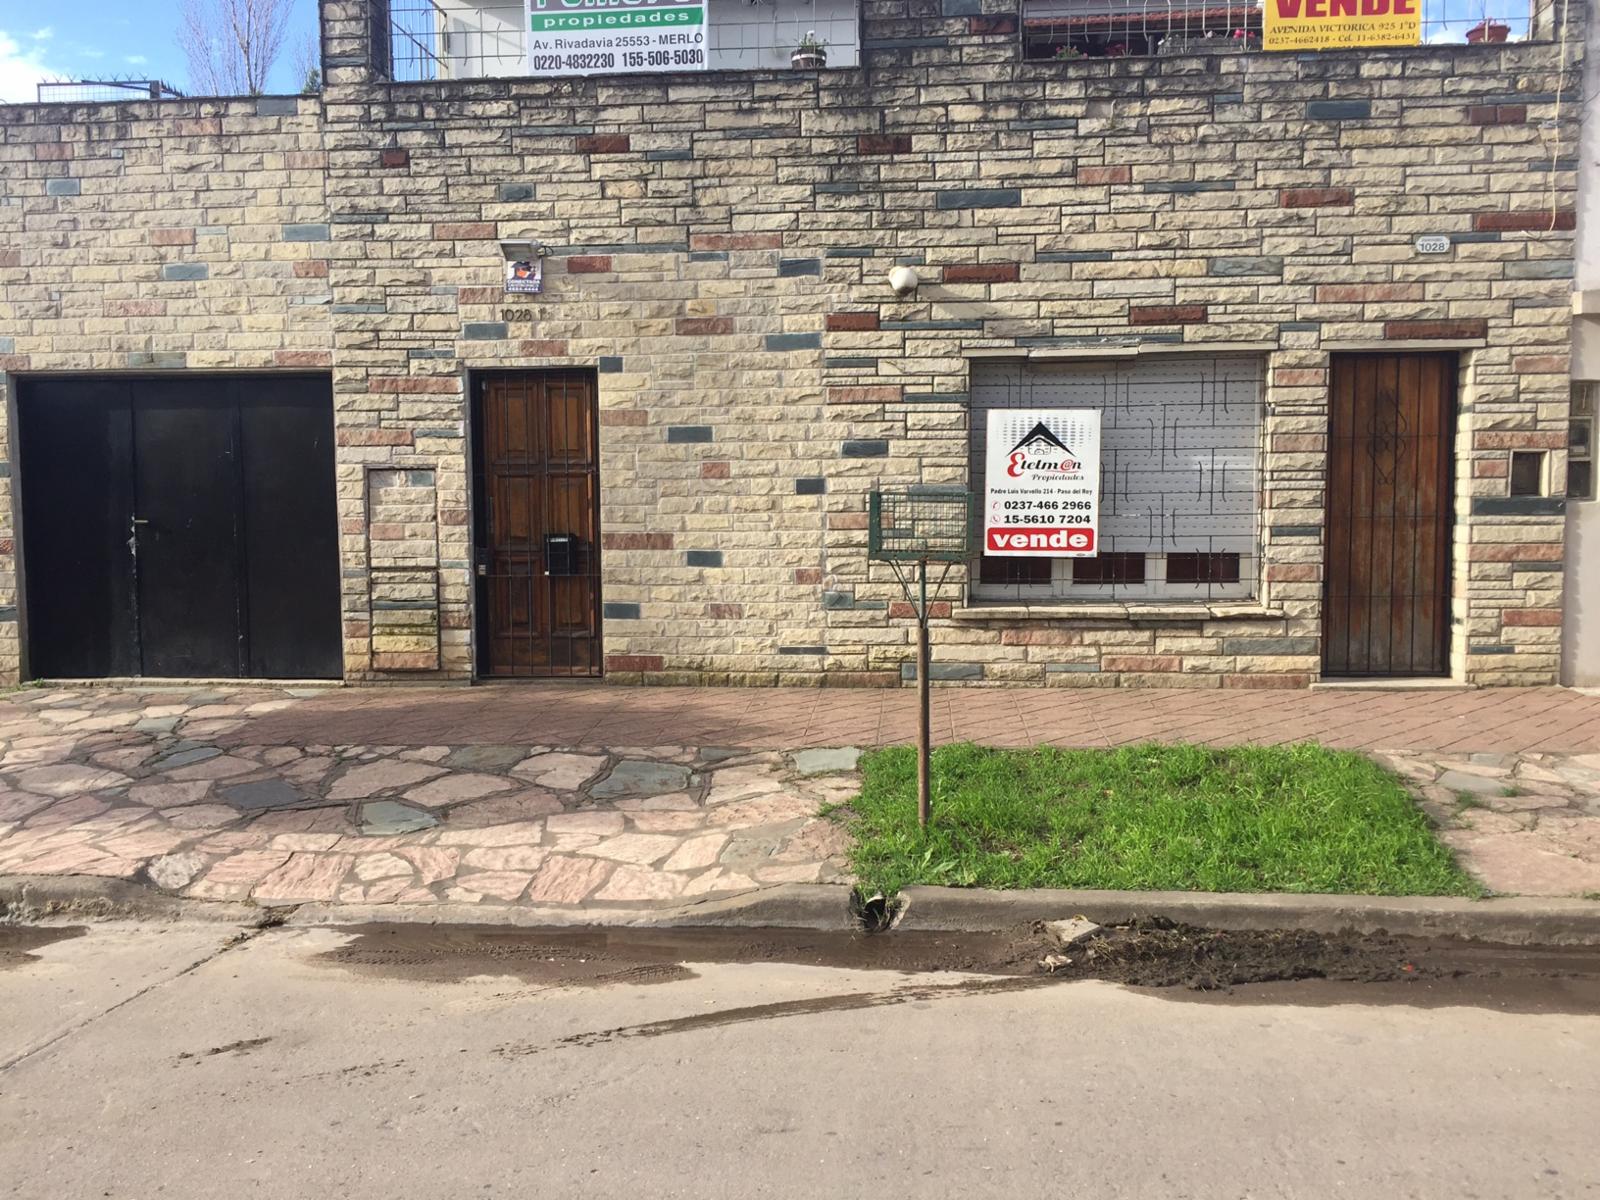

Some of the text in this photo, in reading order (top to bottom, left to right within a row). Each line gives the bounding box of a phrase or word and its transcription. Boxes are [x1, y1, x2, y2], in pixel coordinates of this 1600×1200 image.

[1276, 0, 1415, 18] VENDE
[544, 12, 689, 28] propiedades
[1270, 25, 1316, 34] AVENIDA
[1319, 23, 1375, 32] VICTORICA
[1378, 22, 1396, 31] 925
[533, 40, 552, 50] Av.
[555, 37, 613, 49] Rivadavia
[615, 36, 650, 47] 25553
[658, 32, 703, 45] MERLO
[1268, 36, 1330, 45] 0237-4662418
[534, 49, 704, 71] 0220-4832230 155-506-5030
[1419, 242, 1445, 251] 1028
[500, 308, 532, 322] 1028
[1032, 473, 1084, 482] Propiedades
[1004, 501, 1092, 510] 0237-466 2966
[1004, 515, 1091, 524] 15-5610 7204
[992, 530, 1088, 548] vende
